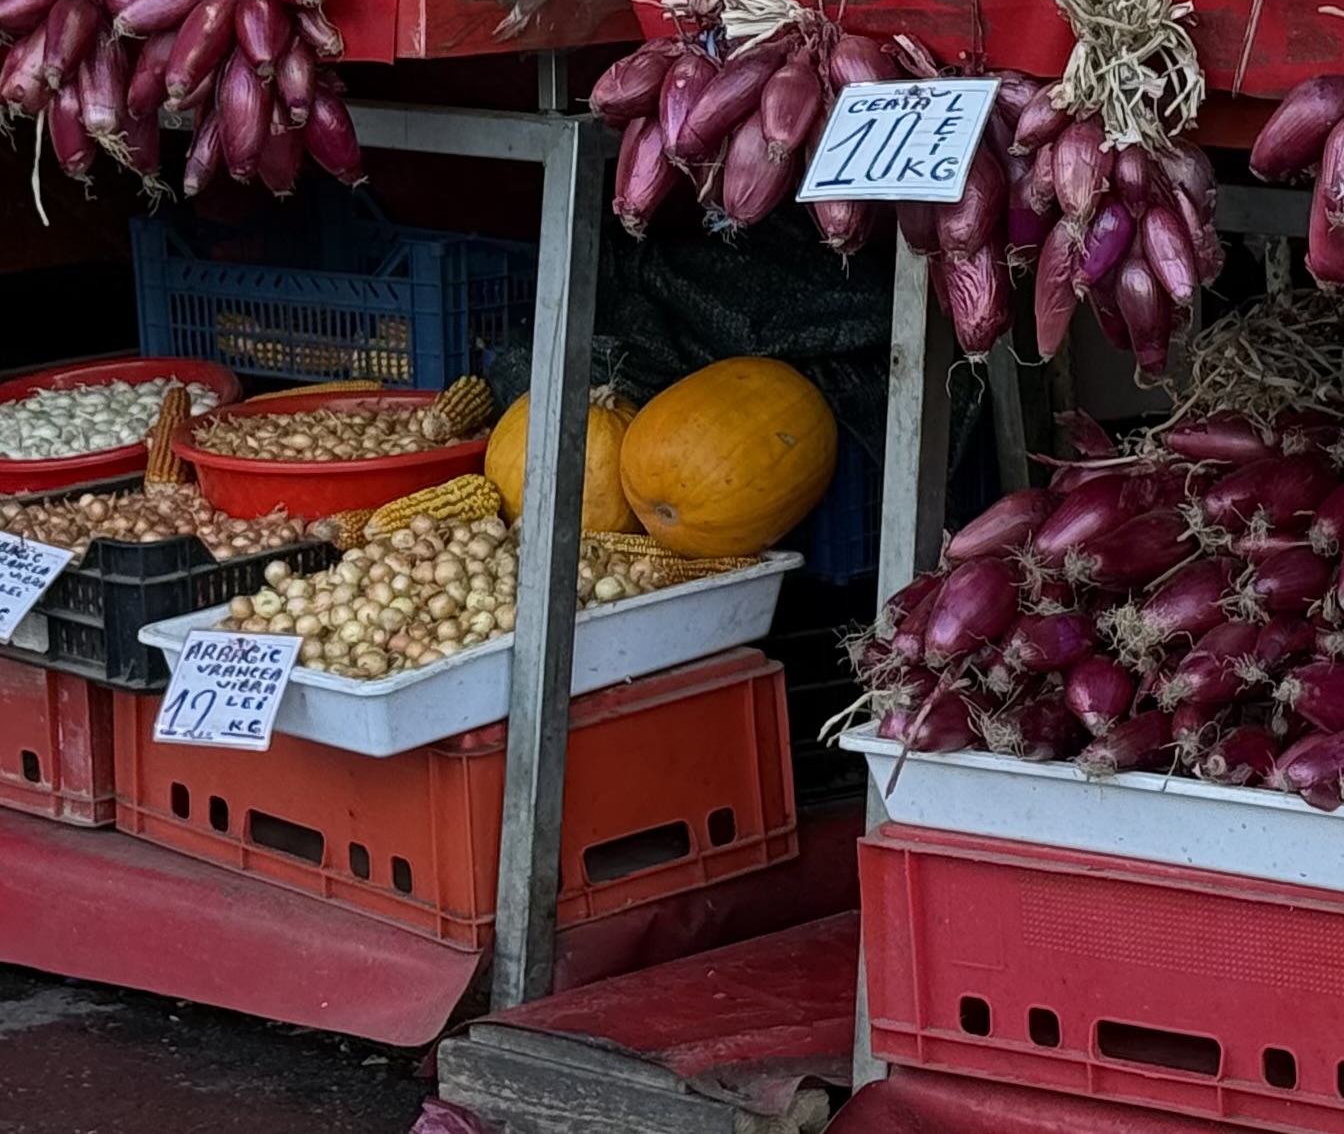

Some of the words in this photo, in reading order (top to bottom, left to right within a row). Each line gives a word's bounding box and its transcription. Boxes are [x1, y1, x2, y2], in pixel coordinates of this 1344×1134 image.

[815, 111, 923, 187] 10
[896, 156, 960, 182] KG
[228, 719, 263, 736] KG
